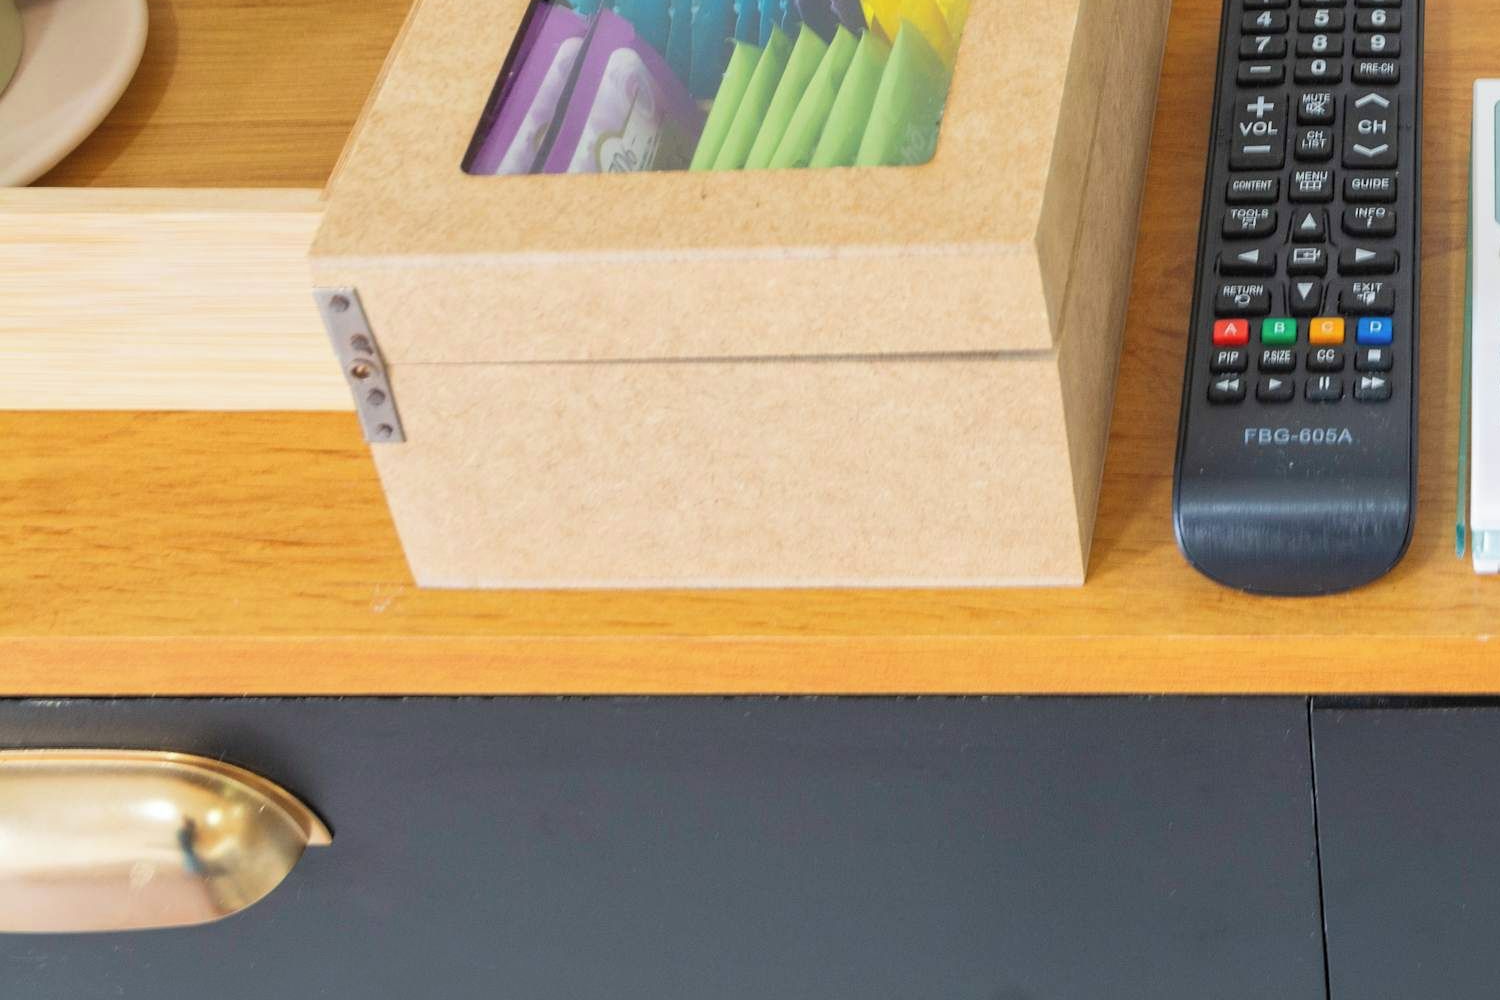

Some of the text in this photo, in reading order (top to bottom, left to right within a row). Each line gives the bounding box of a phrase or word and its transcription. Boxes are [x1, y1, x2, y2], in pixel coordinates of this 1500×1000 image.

[1257, 11, 1272, 27] 4
[1315, 10, 1329, 26] 5
[1371, 10, 1386, 26] 6
[1255, 36, 1271, 53] 7
[1312, 34, 1327, 51] 8
[1371, 35, 1386, 51] 9
[1311, 60, 1326, 75] 0
[1360, 63, 1394, 73] PRE-CH
[1302, 93, 1331, 103] MUTE
[1239, 121, 1278, 136] VOL
[1357, 119, 1387, 134] CH
[1306, 130, 1323, 139] CH
[1301, 139, 1327, 149] LIST
[1295, 171, 1328, 182] MENU
[1233, 180, 1272, 191] CONTENT
[1352, 178, 1390, 189] GUIDE
[1231, 209, 1269, 218] TOOLS
[1355, 207, 1386, 217] INFO
[1223, 285, 1264, 297] RETURN
[1352, 282, 1384, 294] EXIT
[1224, 322, 1238, 336] A
[1274, 321, 1285, 334] B
[1369, 320, 1382, 333] D
[1218, 351, 1239, 363] PIP
[1263, 350, 1291, 363] P.SIZE
[1317, 349, 1335, 361] CC
[1244, 427, 1353, 445] FBG-605A
